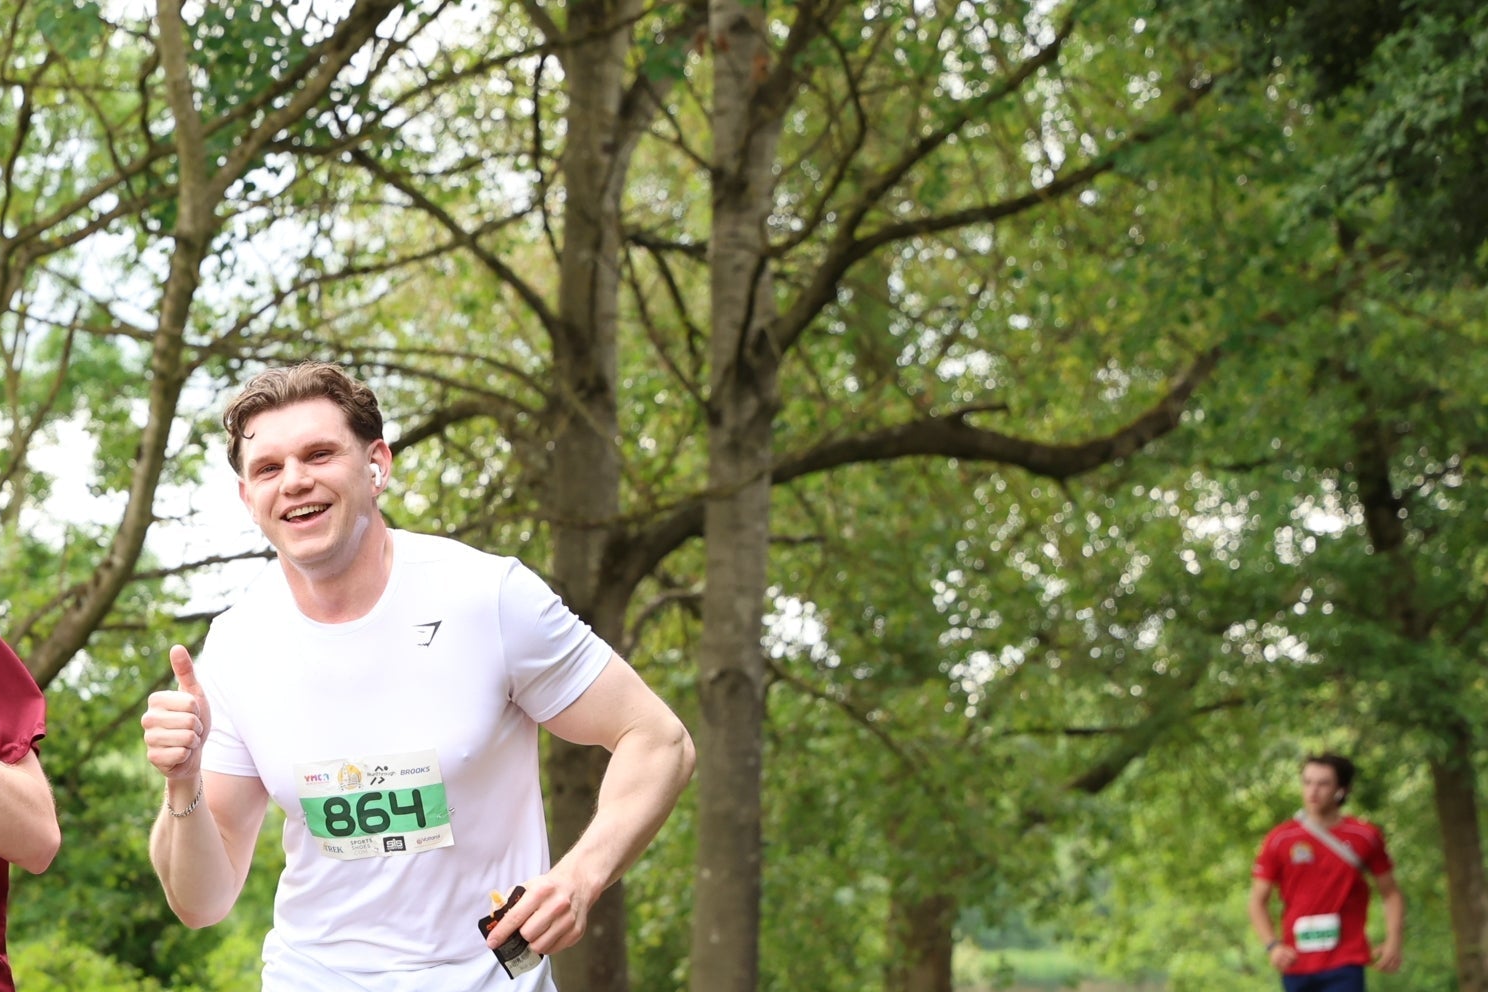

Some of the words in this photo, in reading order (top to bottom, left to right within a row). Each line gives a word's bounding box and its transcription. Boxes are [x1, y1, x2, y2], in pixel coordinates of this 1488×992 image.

[400, 766, 431, 776] BROOKS
[304, 773, 330, 783] YMCA
[323, 788, 427, 837] 864
[323, 845, 344, 854] TREK
